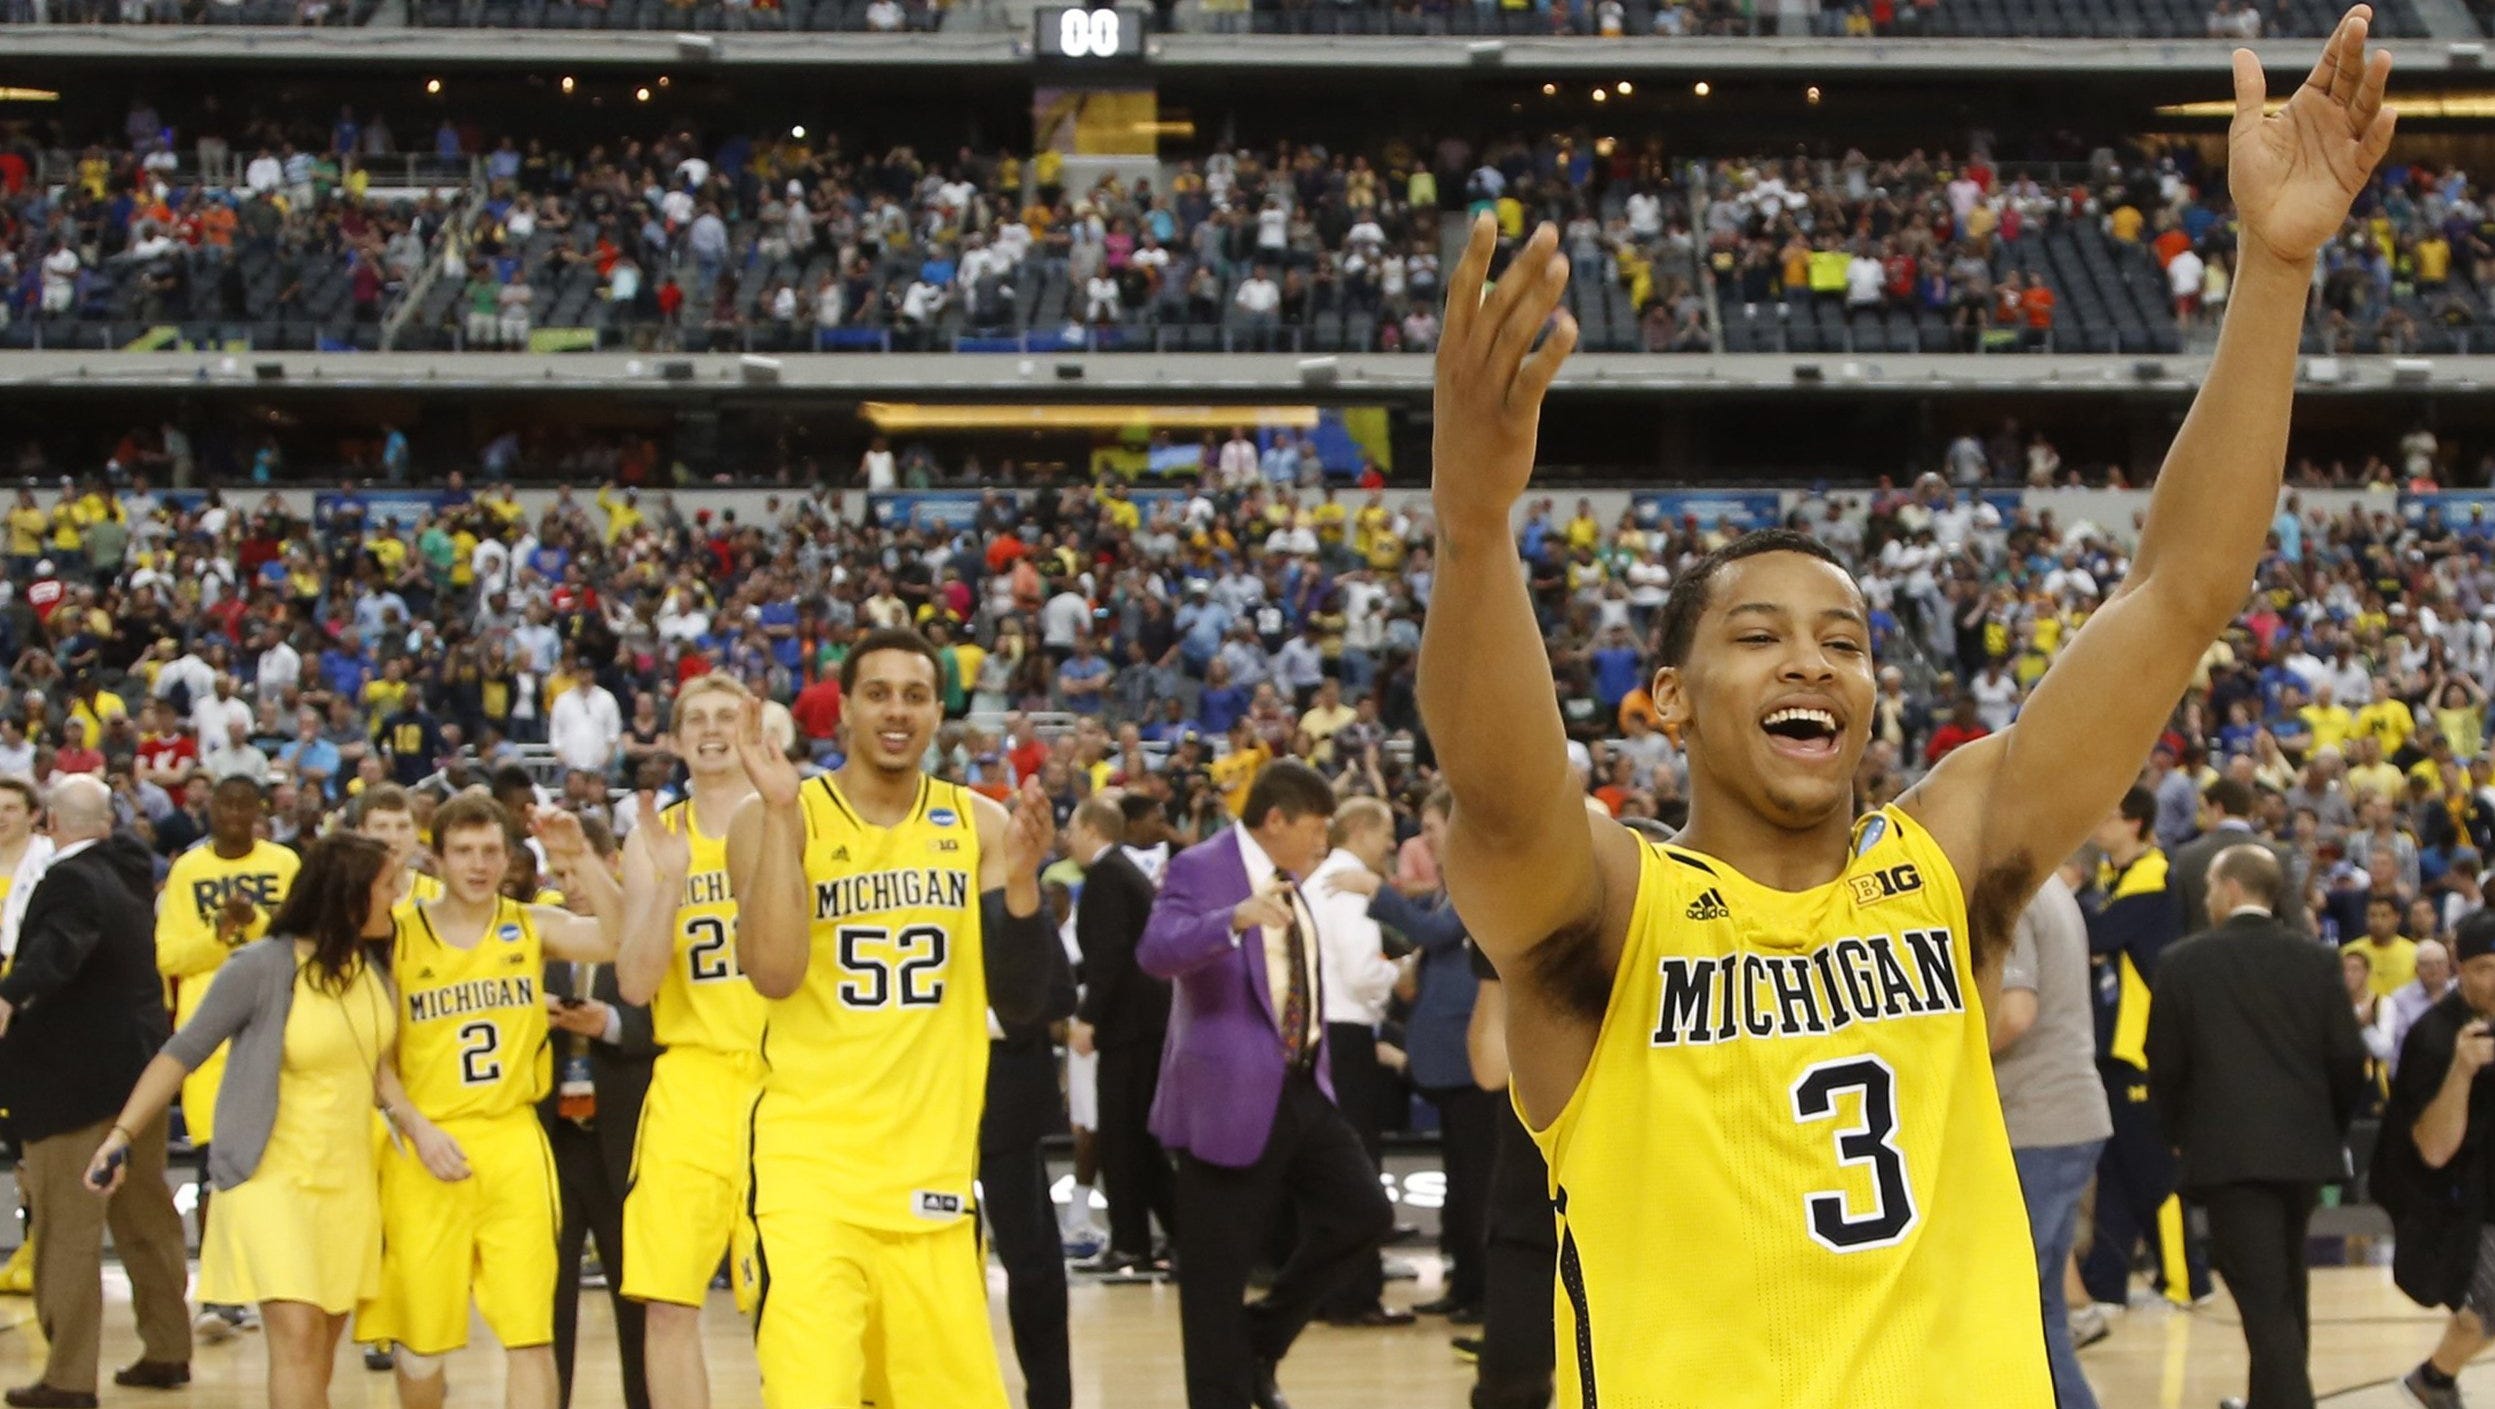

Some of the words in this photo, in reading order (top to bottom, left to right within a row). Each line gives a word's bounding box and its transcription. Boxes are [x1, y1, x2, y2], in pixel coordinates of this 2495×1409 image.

[193, 873, 280, 914] RISE
[814, 868, 969, 921] MICHIGAN
[1848, 864, 1922, 905] BIG
[1685, 905, 1729, 920] adida
[837, 923, 948, 1008] 52
[1650, 927, 1966, 1048] MICHIGAN
[408, 976, 535, 1023] MICHIGAN
[458, 1020, 501, 1086] 2
[1787, 1052, 1920, 1254] 3
